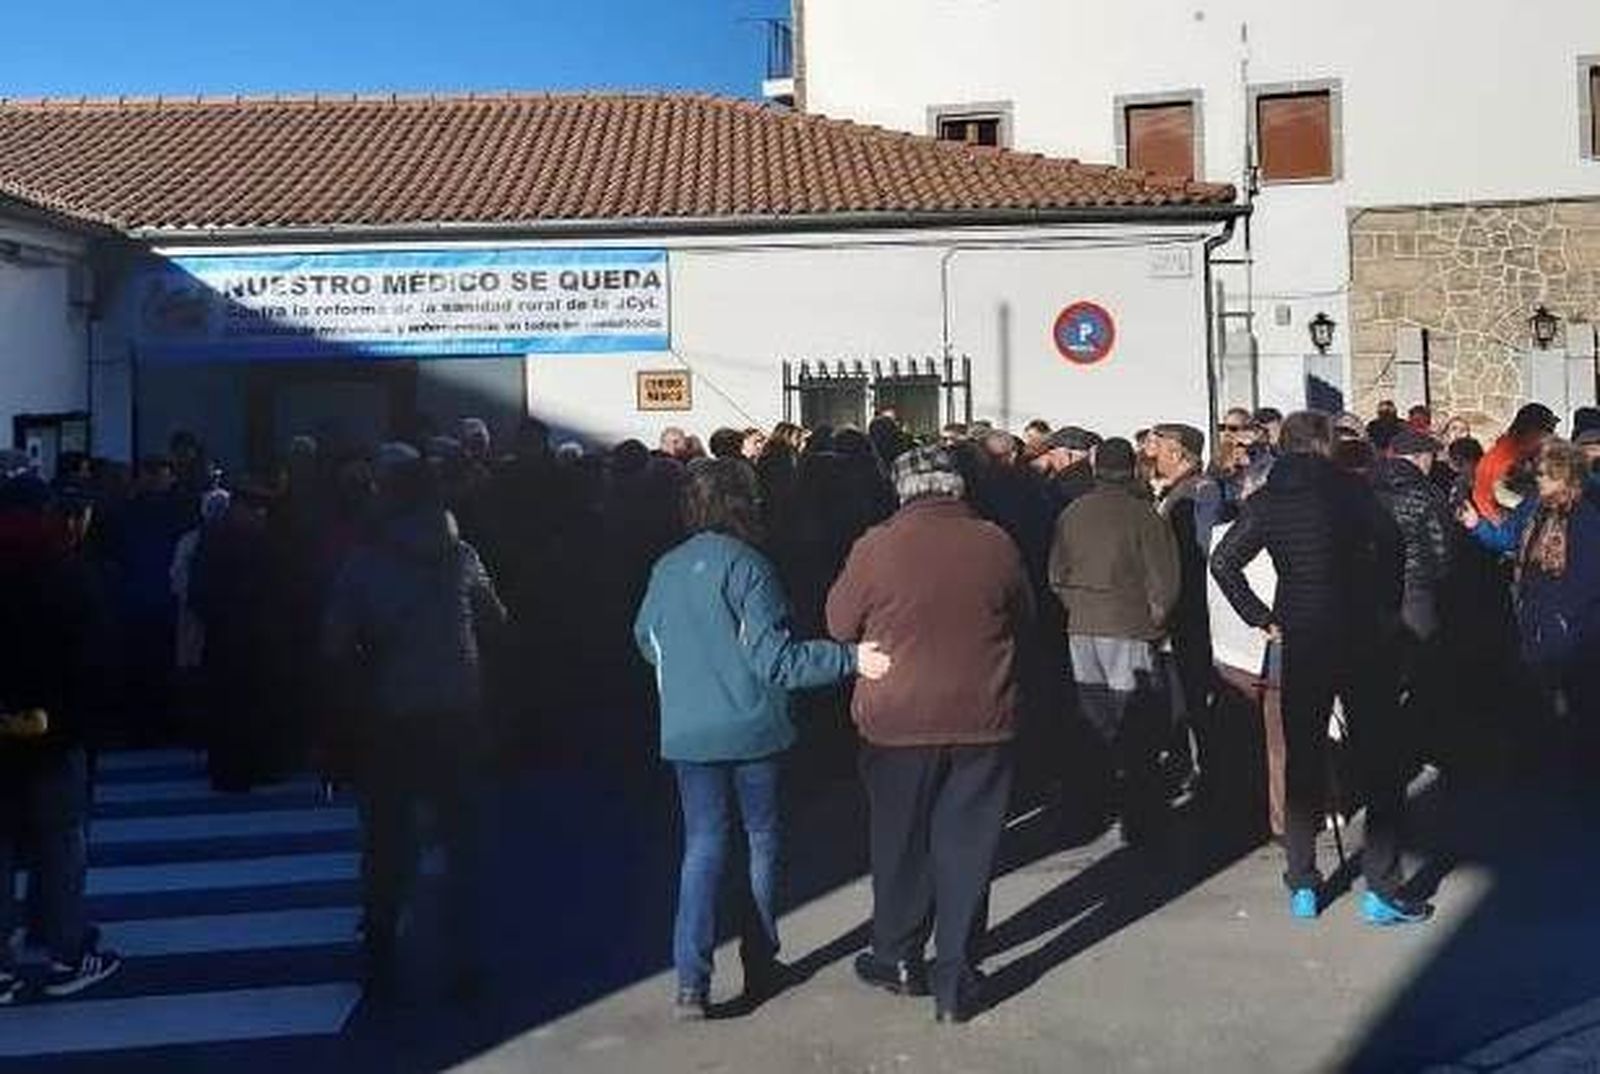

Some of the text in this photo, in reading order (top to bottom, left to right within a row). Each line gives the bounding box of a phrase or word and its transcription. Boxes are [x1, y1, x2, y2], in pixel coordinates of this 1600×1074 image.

[224, 275, 371, 298] NUESTRO
[511, 270, 547, 292] SE
[560, 269, 662, 291] QUEDA
[315, 303, 387, 316] reform
[518, 299, 560, 312] rural
[566, 298, 587, 310] de
